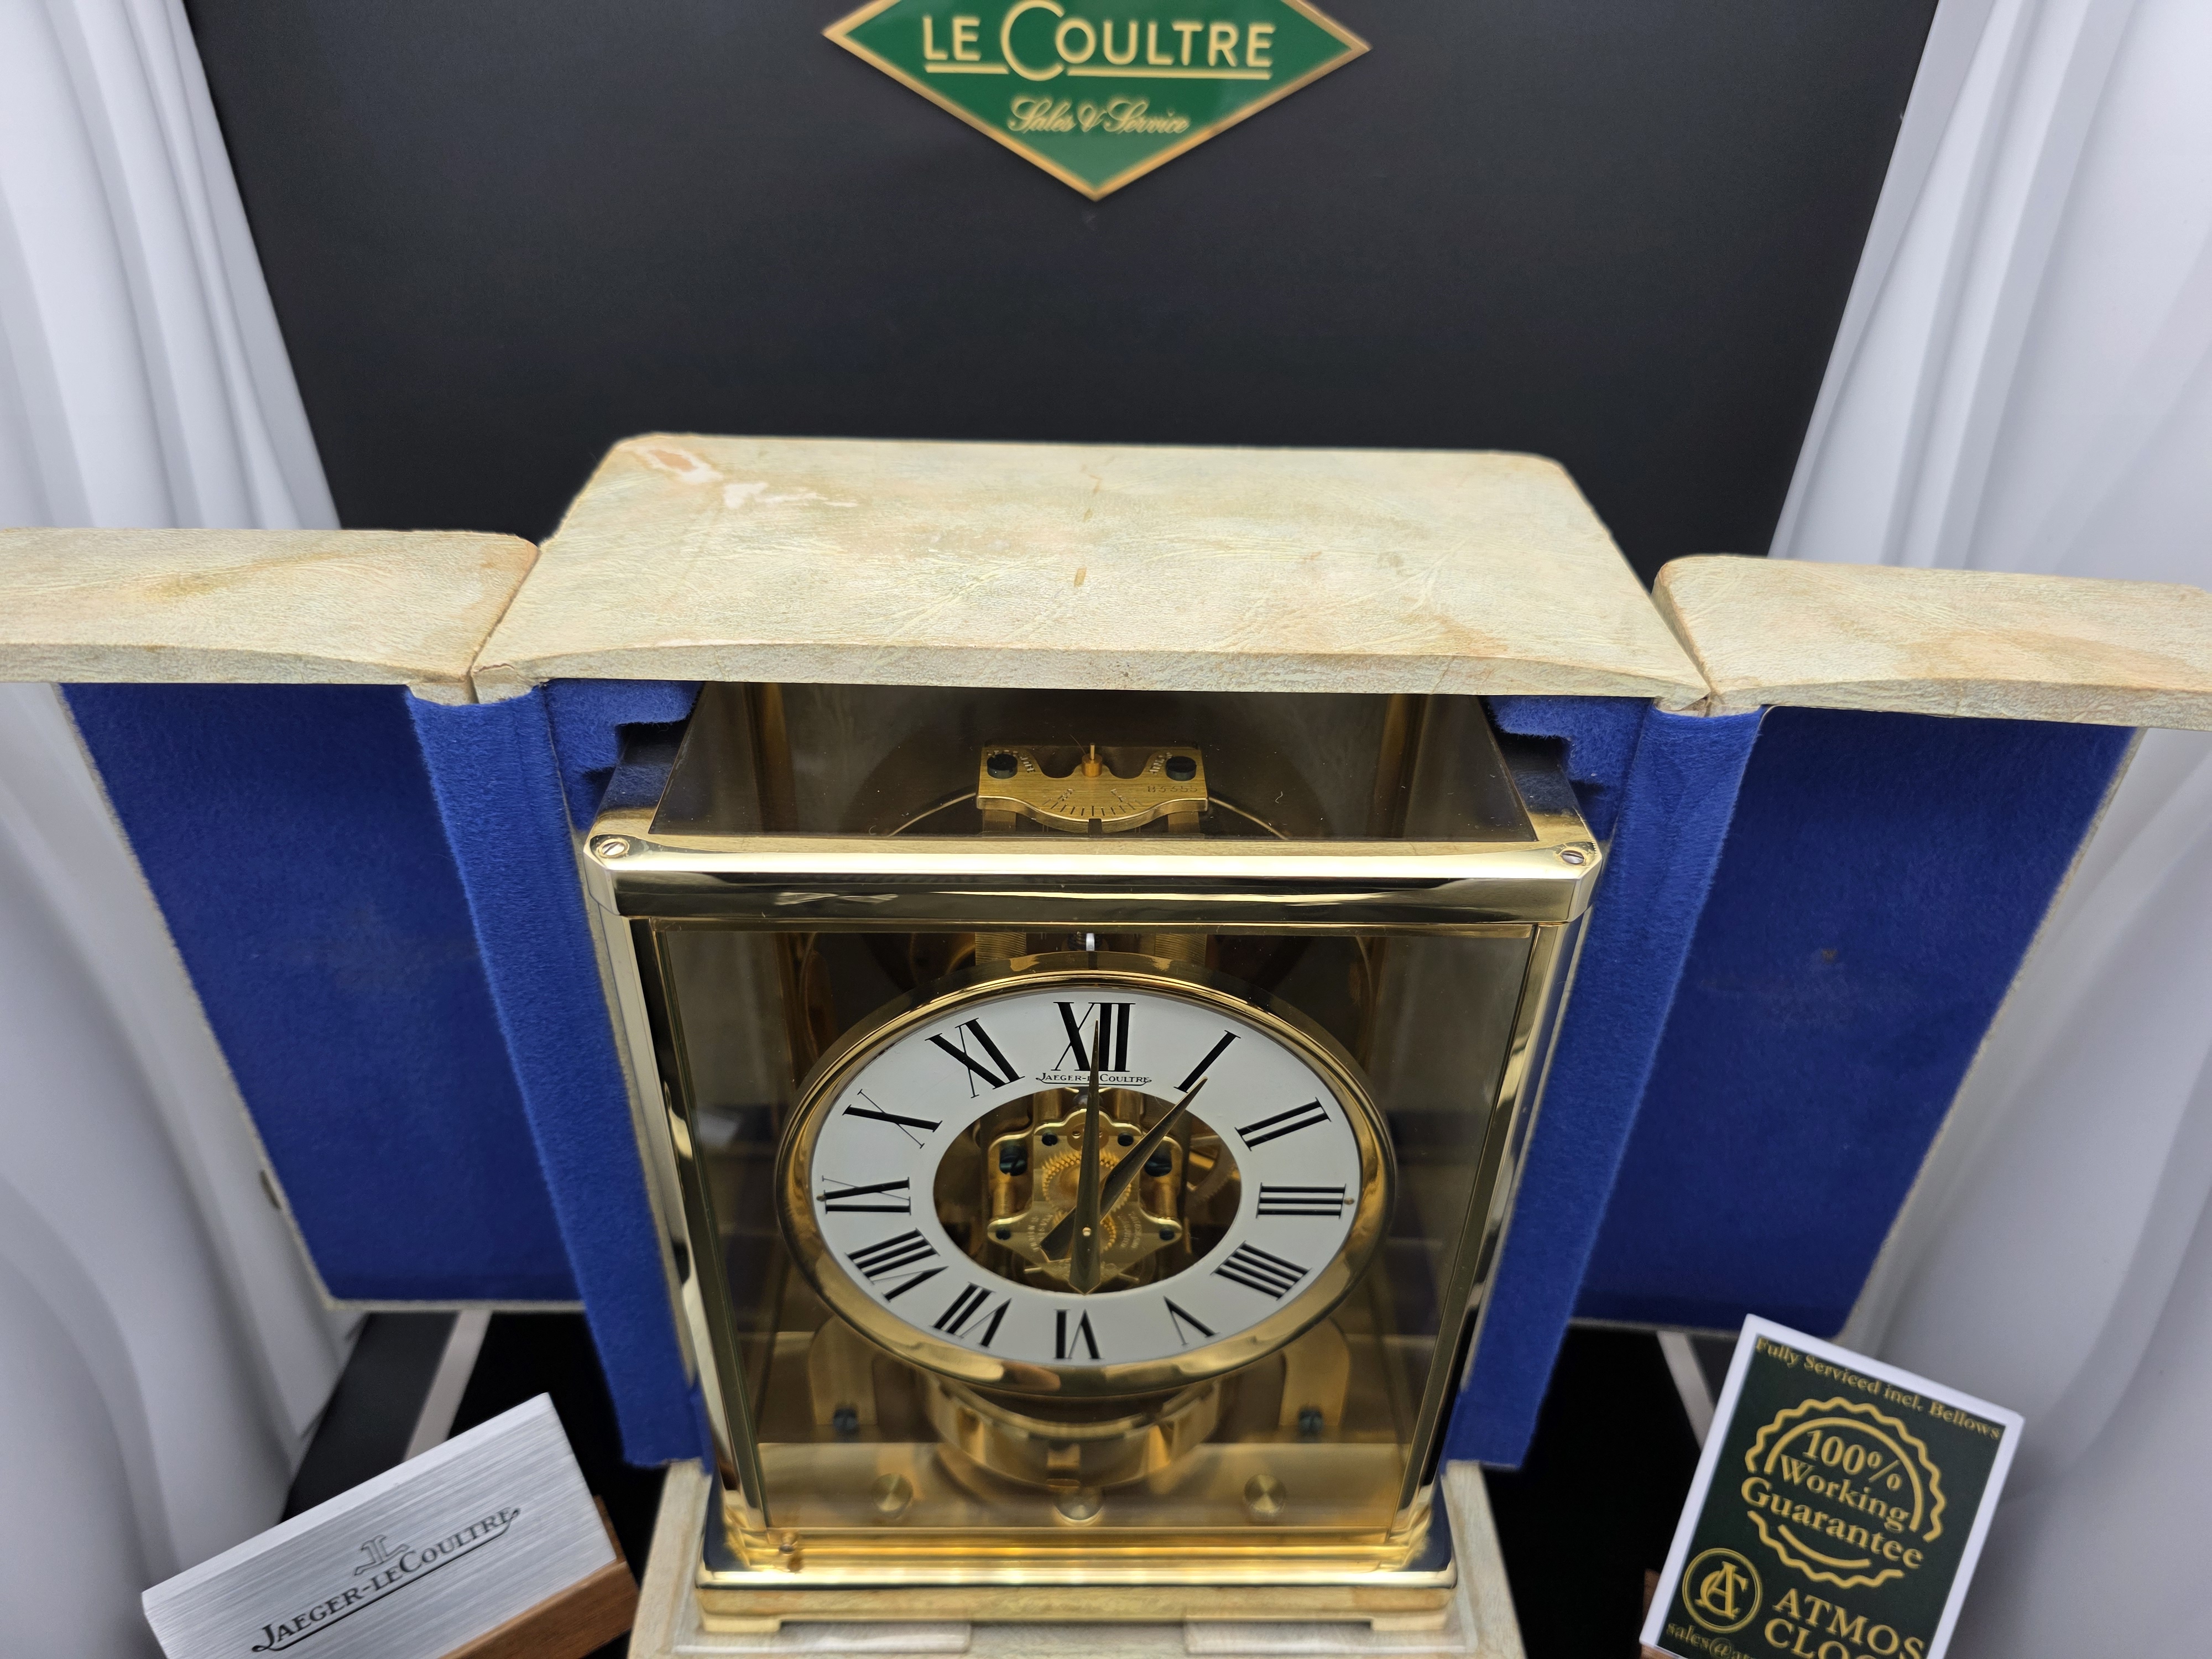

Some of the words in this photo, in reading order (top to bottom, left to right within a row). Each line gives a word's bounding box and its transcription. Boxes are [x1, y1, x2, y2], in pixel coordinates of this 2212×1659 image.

[922, 15, 980, 61] LE
[1000, 0, 1275, 81] COULTRE
[1008, 95, 1076, 134] Sales
[1103, 95, 1190, 134] Service
[925, 1018, 1025, 1098] XI
[1051, 1001, 1136, 1072] XII
[1177, 1030, 1241, 1093] I
[843, 1089, 943, 1149] X
[1235, 1098, 1332, 1151] II
[822, 1176, 911, 1214] IX
[1256, 1183, 1346, 1219] III
[847, 1229, 948, 1302] VIII
[1212, 1243, 1311, 1301] IIII
[932, 1282, 1012, 1348] VII
[1054, 1309, 1102, 1360] VI
[1164, 1296, 1219, 1346] V
[1756, 1337, 1800, 1368] Fully
[1804, 1354, 1880, 1395] Serviced
[1884, 1384, 1924, 1411] incl.
[1928, 1401, 2001, 1439] Bellows
[1803, 1430, 1902, 1491] 100%
[1741, 1477, 1923, 1568] Guarantee
[1780, 1453, 1910, 1533] Working
[1772, 1588, 1925, 1659] ATMOS
